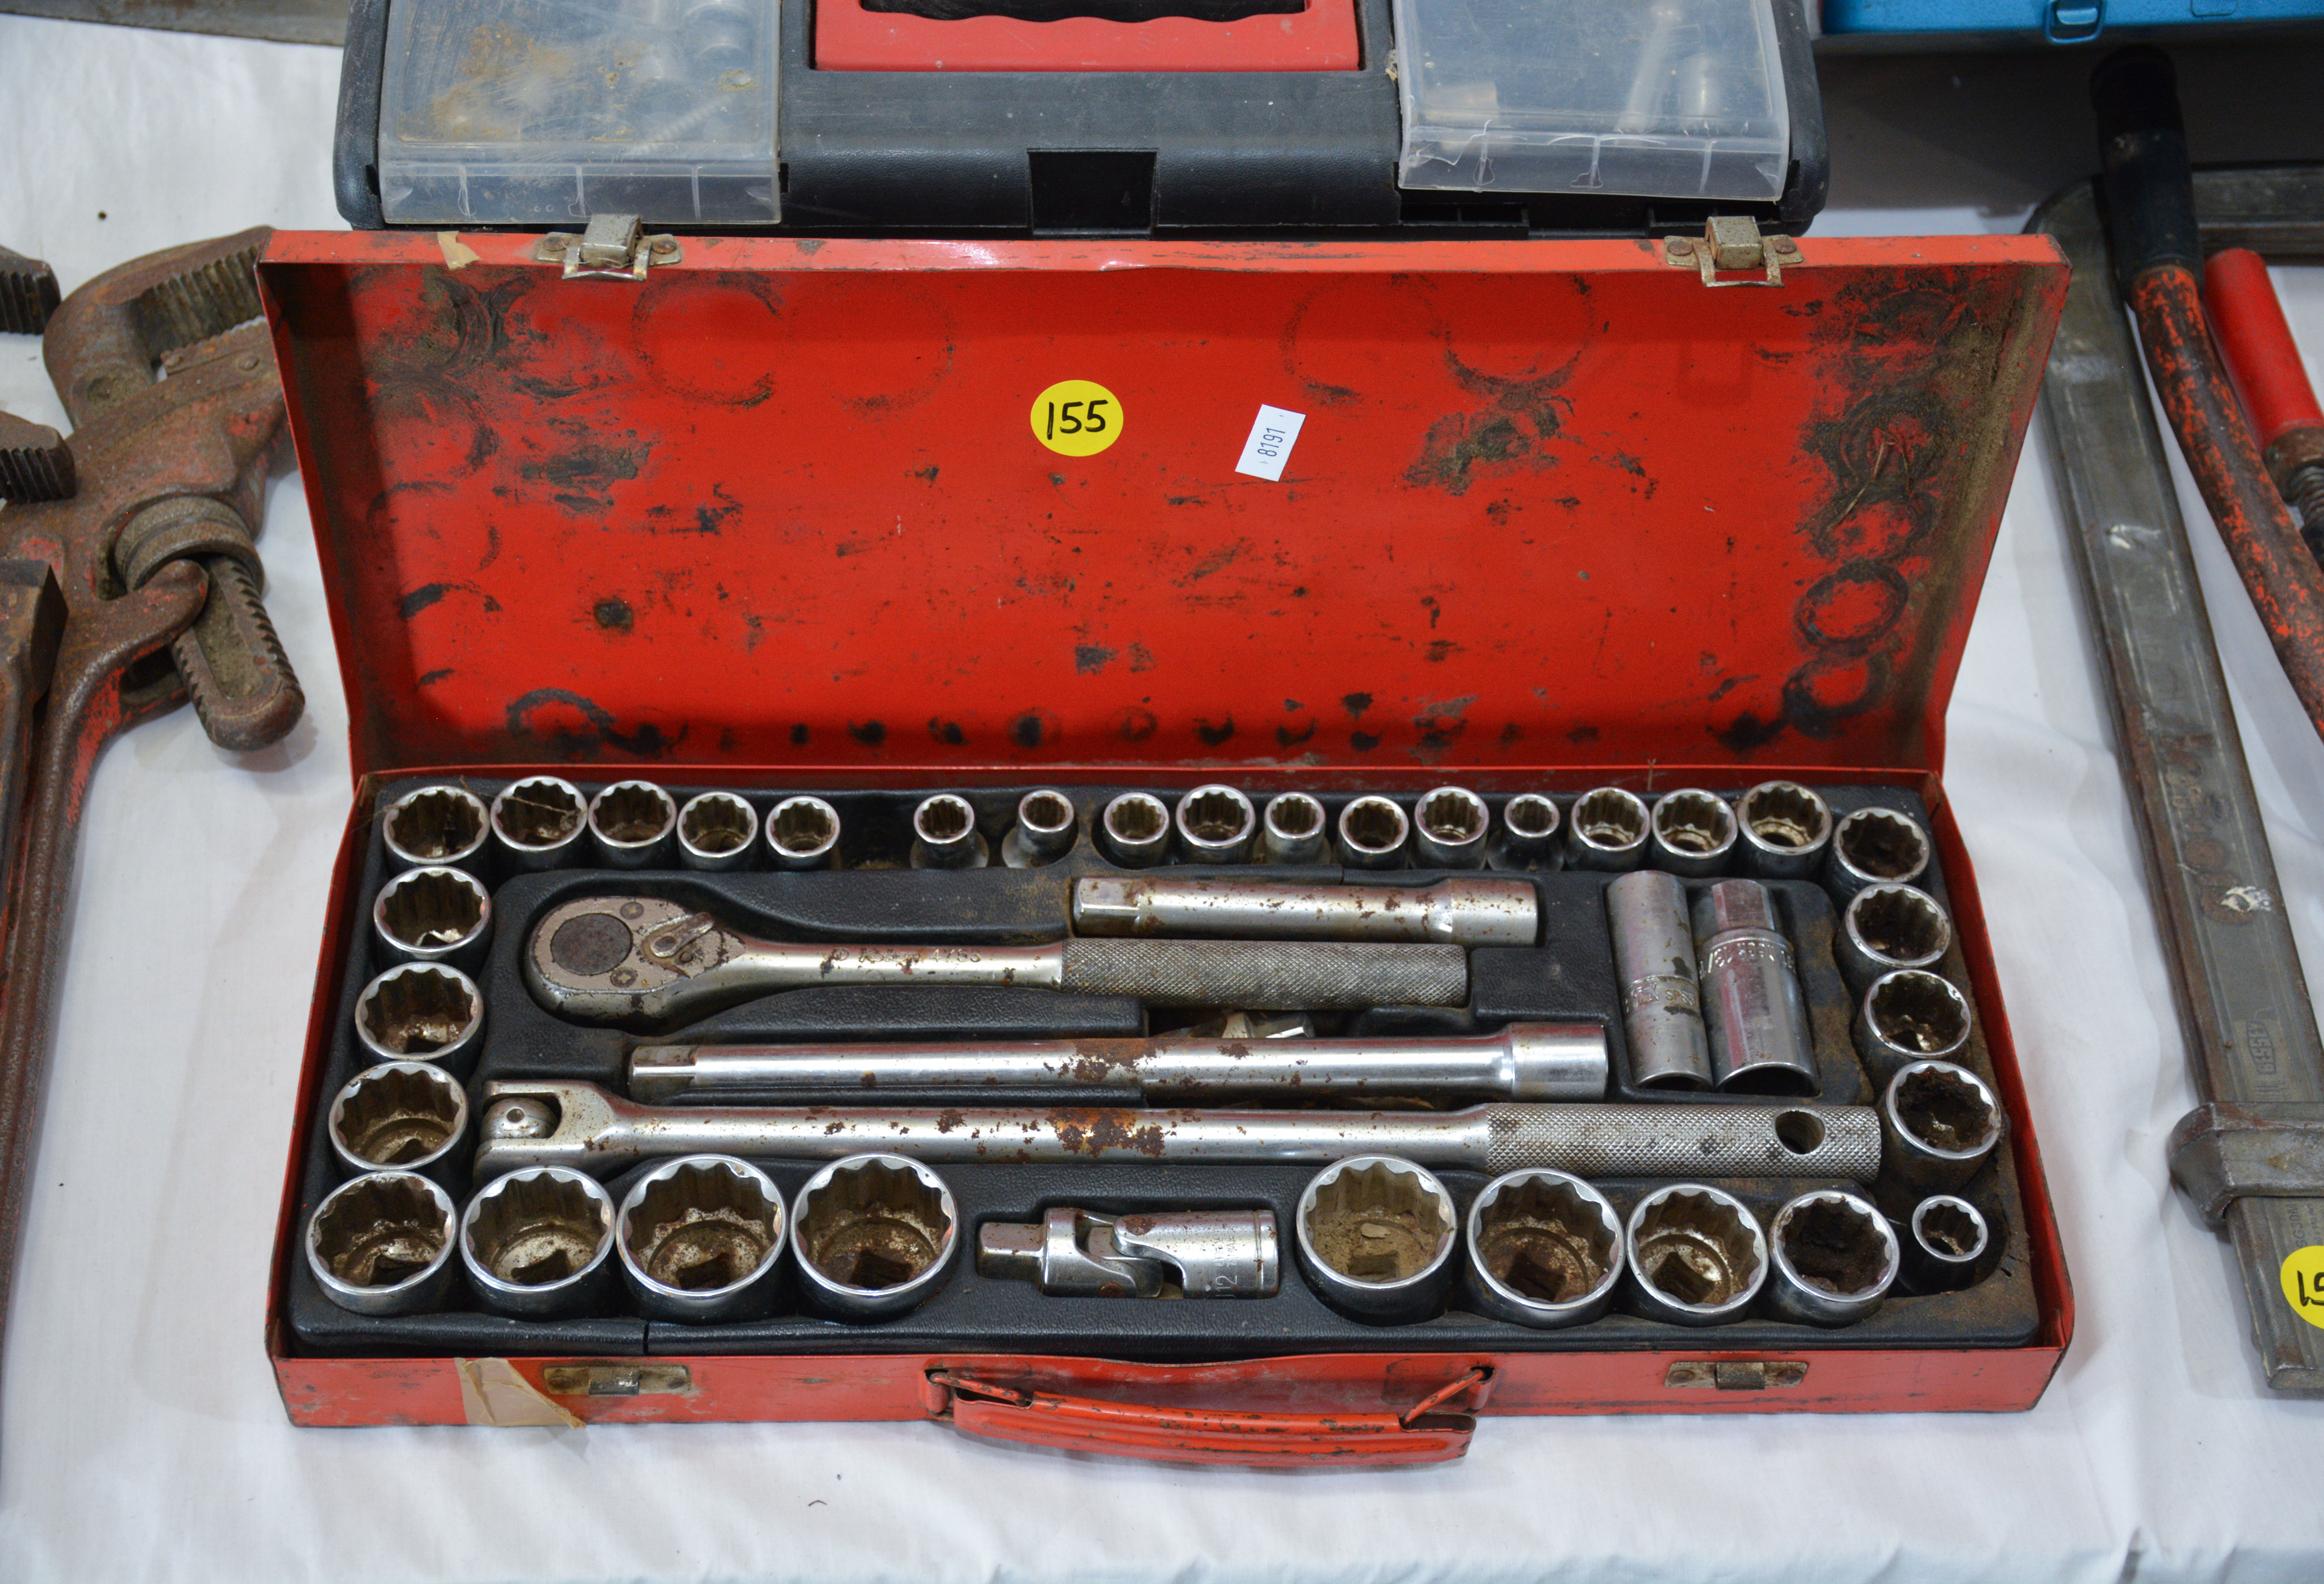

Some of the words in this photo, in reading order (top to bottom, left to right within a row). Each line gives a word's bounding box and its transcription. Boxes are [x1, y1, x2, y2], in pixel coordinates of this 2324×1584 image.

[1046, 399, 1109, 440] 155
[1257, 427, 1286, 457] 8191
[2247, 1021, 2277, 1074] BESSEY
